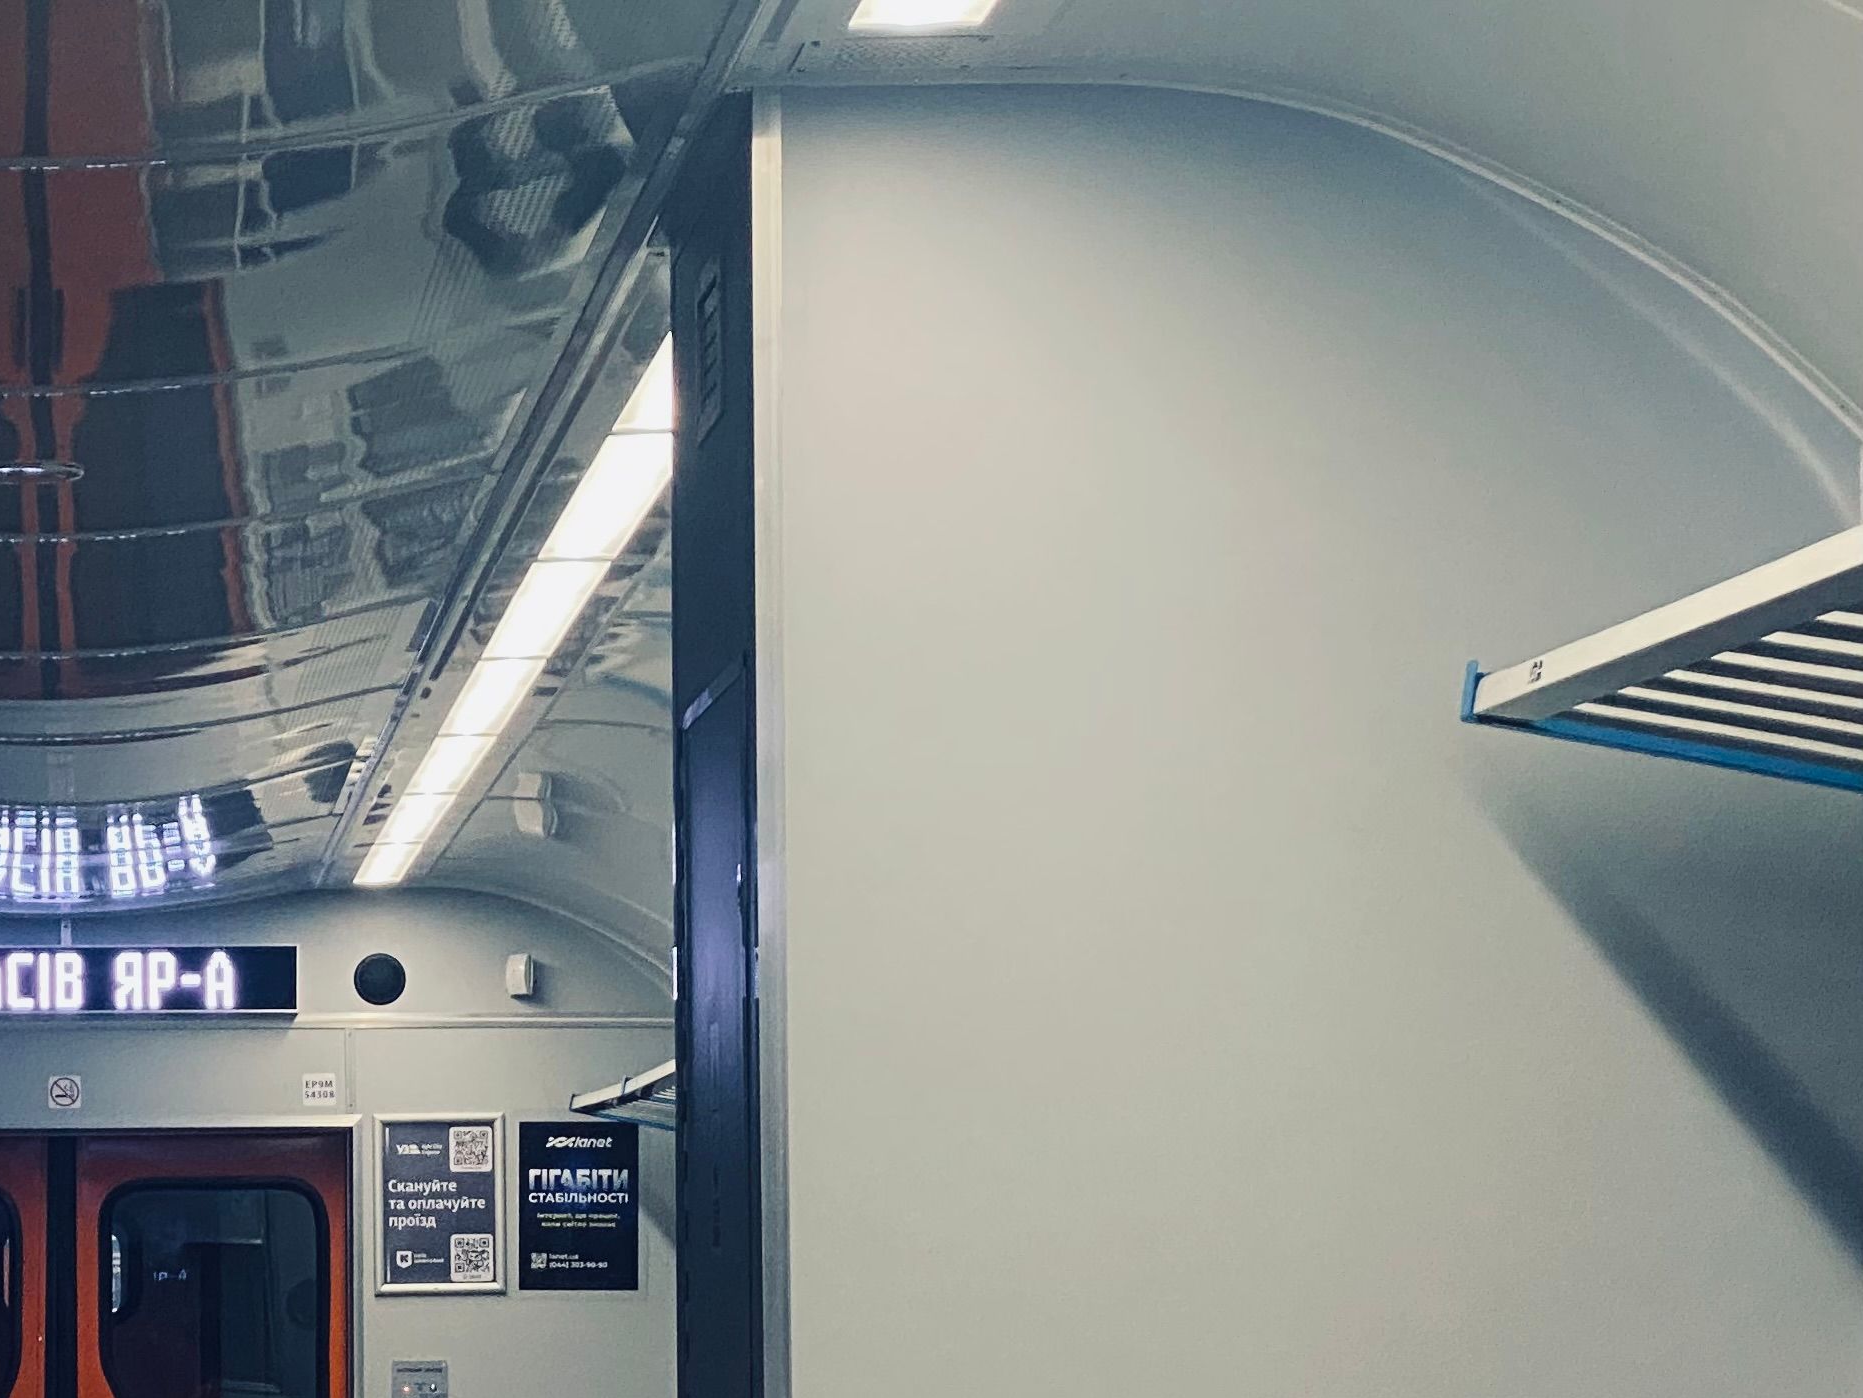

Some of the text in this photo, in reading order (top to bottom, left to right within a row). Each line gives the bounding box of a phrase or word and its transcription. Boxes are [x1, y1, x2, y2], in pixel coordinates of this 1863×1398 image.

[112, 951, 236, 1011] ЯР-А
[388, 1179, 458, 1196] Скануйте
[528, 1168, 629, 1191] ГІГАБІТИ
[389, 1196, 486, 1213] та оплачуйте
[528, 1192, 629, 1205] СТАБІЛЬНОСТІ
[388, 1213, 437, 1231] проїзд
